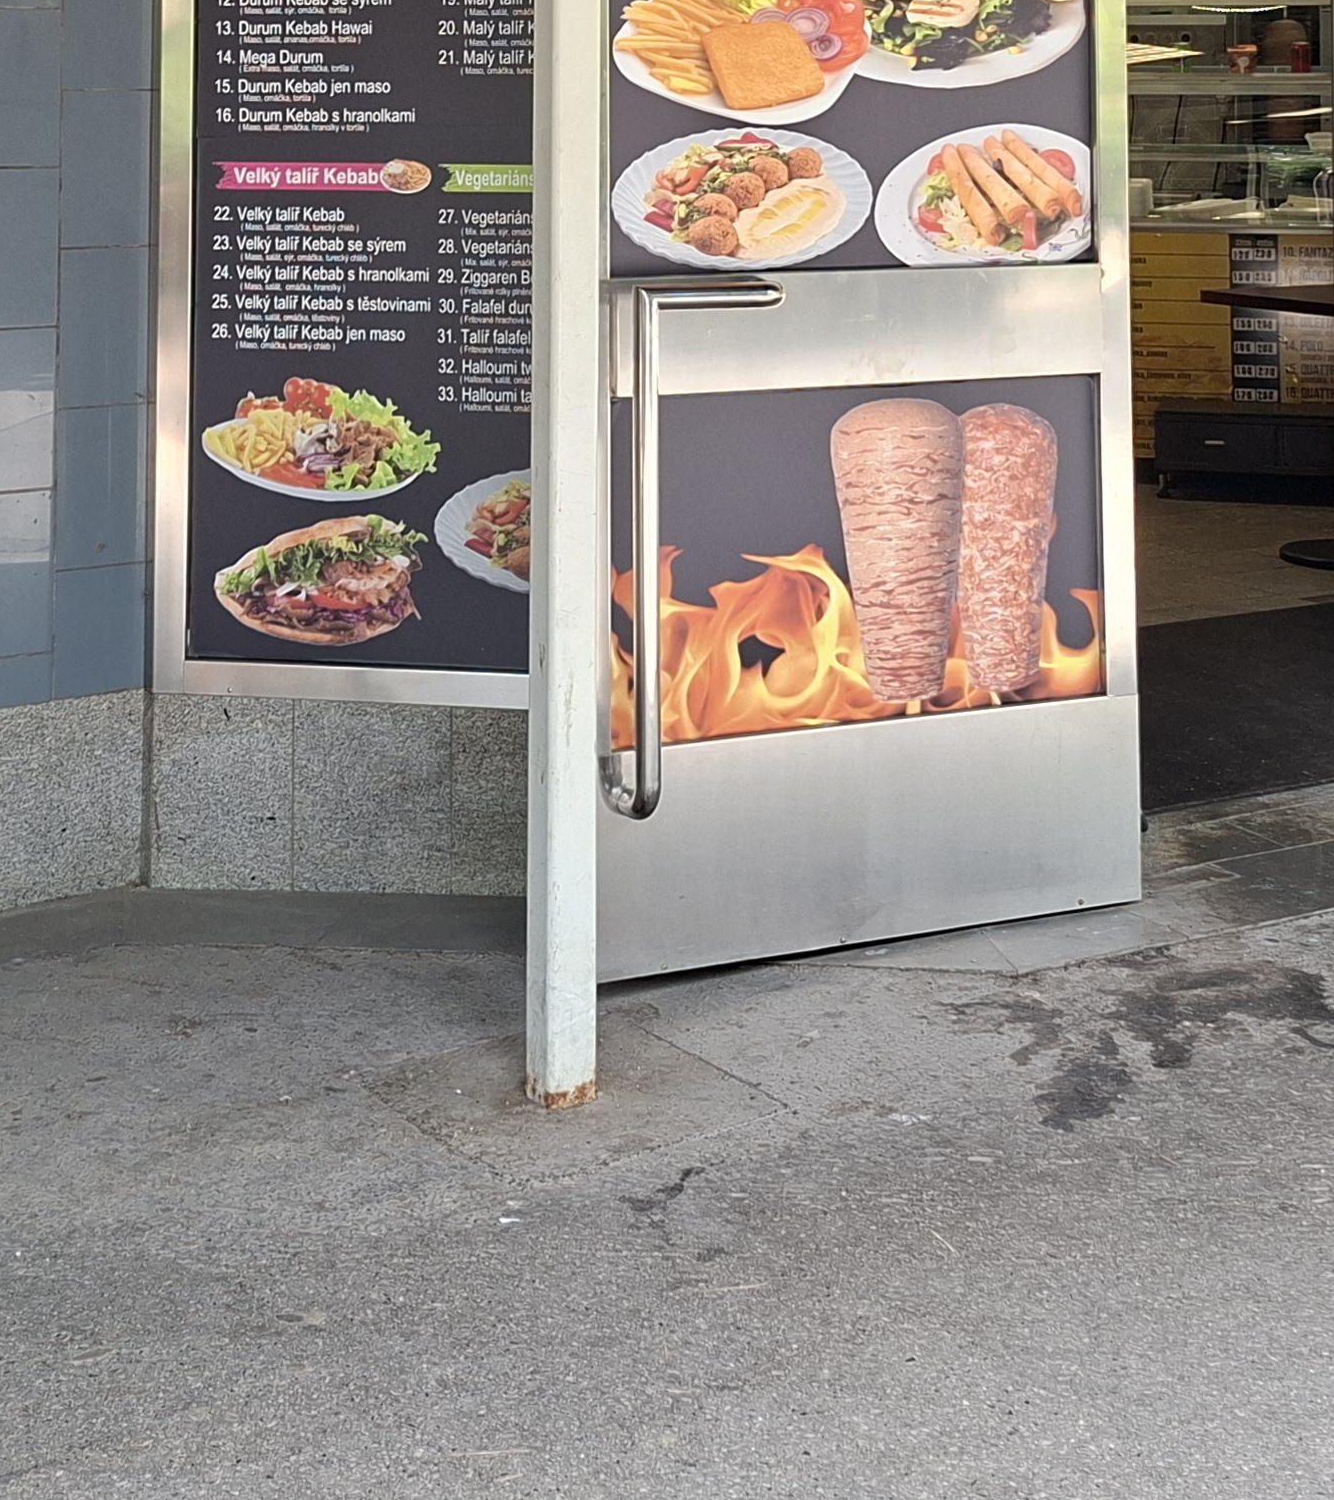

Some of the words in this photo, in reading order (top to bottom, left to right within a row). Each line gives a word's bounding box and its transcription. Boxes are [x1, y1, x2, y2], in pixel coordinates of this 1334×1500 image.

[216, 21, 234, 35] 13.
[239, 21, 282, 35] Durum
[286, 21, 327, 34] Kebab
[332, 20, 372, 34] Hawai
[438, 21, 459, 35] 20.
[464, 21, 495, 38] Malý
[499, 20, 524, 34] talíř
[216, 50, 235, 64] 14.
[239, 50, 275, 67] Mega
[280, 50, 323, 64] Durum
[438, 50, 459, 65] 21.
[464, 50, 495, 68] Malý
[499, 50, 524, 64] talíř
[215, 80, 234, 93] 15.
[238, 79, 281, 93] Durum
[286, 79, 327, 93] Kebab
[330, 79, 350, 96] jen
[355, 82, 390, 93] maso
[216, 108, 234, 122] 16.
[239, 108, 282, 122] Durum
[286, 108, 328, 122] Kebab
[332, 112, 339, 121] s
[344, 108, 415, 122] hranolkami
[234, 167, 281, 188] Velký
[286, 167, 319, 184] talíř
[324, 168, 378, 184] Kebab
[214, 206, 233, 221] 22.
[238, 207, 272, 224] Velký
[276, 207, 300, 221] talíř
[303, 207, 344, 221] Kebab
[438, 209, 457, 224] 27.
[462, 209, 533, 227] Vegetarián
[213, 236, 233, 250] 23.
[237, 236, 271, 253] Velký
[275, 236, 299, 251] talíř
[303, 237, 344, 251] Kebab
[348, 240, 362, 251] se
[367, 237, 406, 255] sýrem
[438, 239, 457, 253] 28.
[462, 239, 533, 257] Vegetarián
[213, 265, 232, 280] 24.
[237, 265, 271, 282] Velký
[275, 266, 299, 280] talíř
[303, 266, 344, 281] Kebab
[348, 270, 355, 281] s
[359, 267, 429, 282] hranolkami
[438, 269, 457, 283] 29.
[461, 269, 517, 287] Ziggaren
[212, 295, 231, 309] 25.
[236, 295, 270, 312] Velký
[274, 295, 298, 310] talíř
[302, 296, 343, 310] Kebab
[347, 300, 354, 311] s
[358, 297, 431, 312] těstovinami
[439, 298, 458, 314] 30.
[463, 299, 505, 314] Falafel
[212, 325, 231, 339] 26.
[236, 325, 270, 342] Velký
[274, 325, 298, 339] talíř
[302, 326, 343, 340] Kebab
[346, 326, 366, 344] jen
[370, 329, 405, 341] maso
[438, 329, 457, 343] 31.
[461, 329, 490, 344] Talíř
[493, 330, 530, 345] falafel
[438, 359, 457, 374] 32.
[462, 359, 517, 374] Halloumi
[438, 387, 457, 401] 33.
[462, 387, 517, 402] Halloumi
